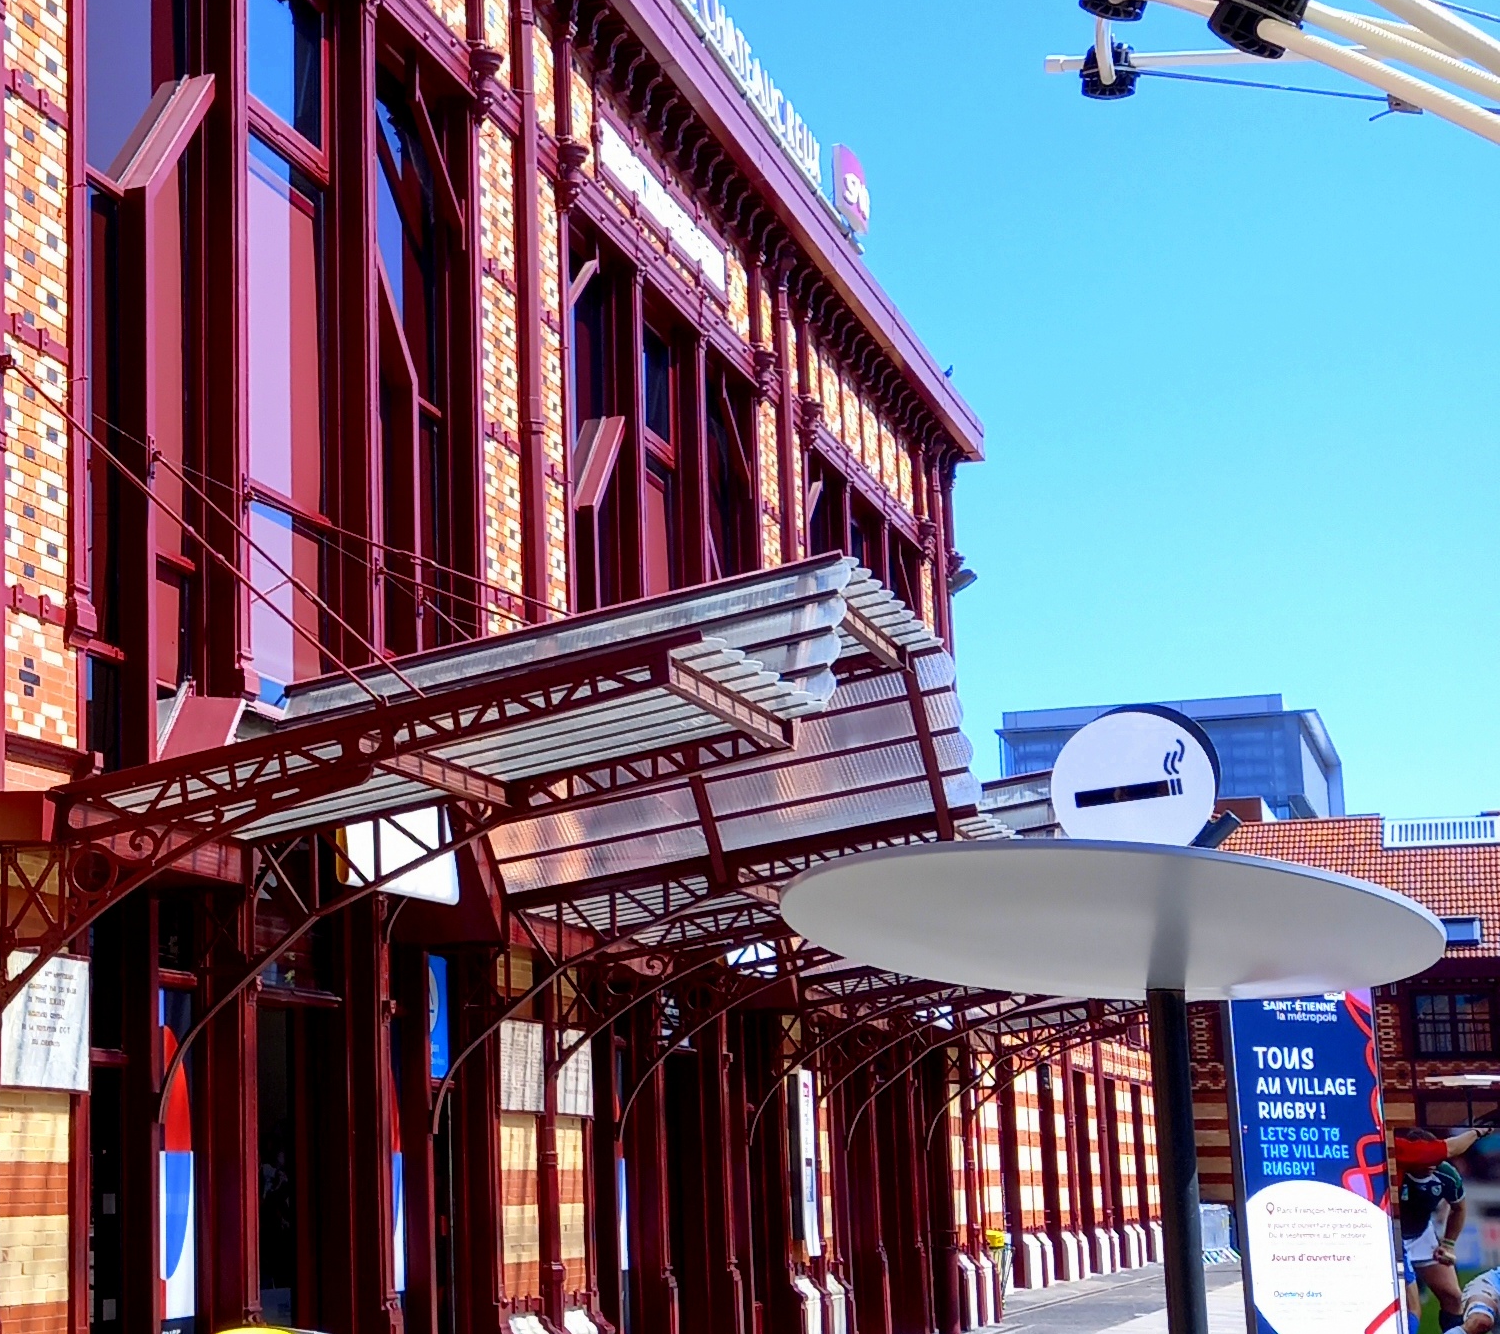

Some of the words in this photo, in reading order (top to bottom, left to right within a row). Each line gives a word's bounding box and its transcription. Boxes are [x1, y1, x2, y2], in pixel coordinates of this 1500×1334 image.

[1263, 1000, 1337, 1012] SAINT-ÉTIENNE
[1276, 1011, 1286, 1020] la
[1288, 1012, 1337, 1023] métropole
[1253, 1047, 1314, 1069] TOUS
[1256, 1077, 1281, 1095] AU
[1285, 1078, 1357, 1095] VILLAGE
[1258, 1101, 1317, 1119] RUGBY
[1260, 1127, 1296, 1141] LET'S
[1300, 1127, 1318, 1141] GO
[1321, 1127, 1340, 1141] TO
[1260, 1144, 1289, 1158] THE
[1292, 1144, 1349, 1159] VILLAGE
[1263, 1161, 1316, 1175] RUGBY!
[1274, 1291, 1304, 1299] Opening
